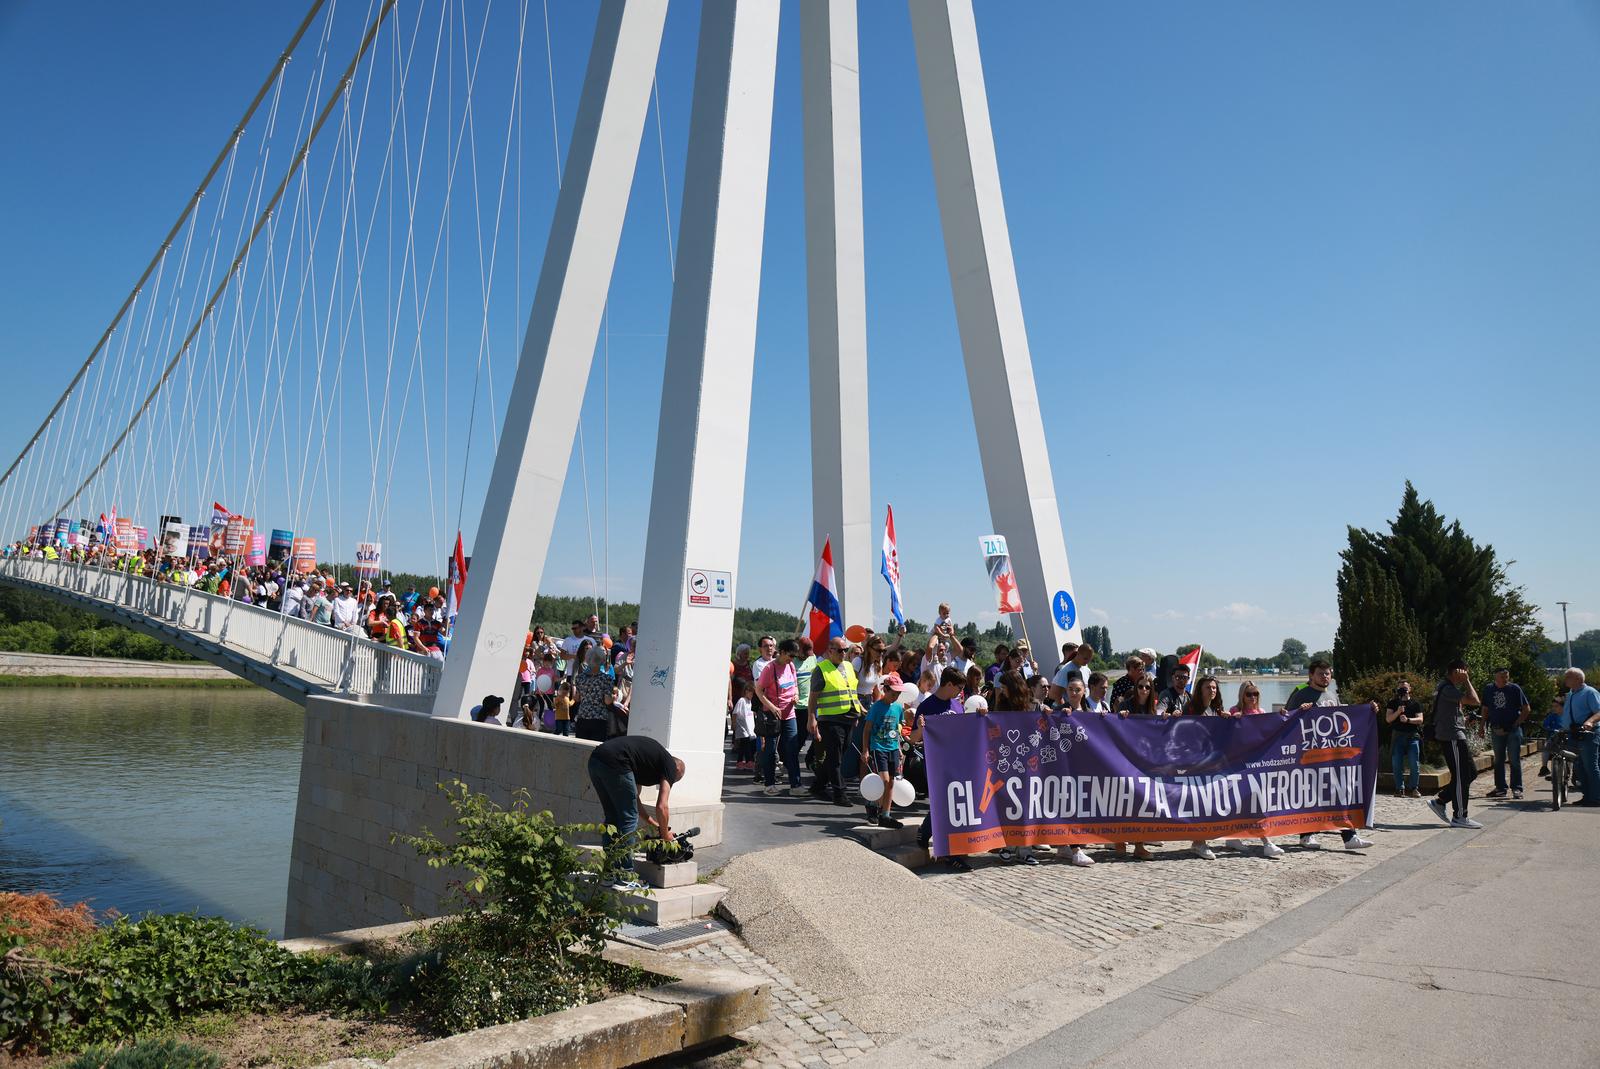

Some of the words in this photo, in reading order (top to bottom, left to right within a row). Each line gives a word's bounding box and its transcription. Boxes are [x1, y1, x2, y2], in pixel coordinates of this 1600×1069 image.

[984, 541, 998, 555] ZA
[1299, 711, 1352, 741] HOD
[1302, 737, 1319, 751] ZA
[1321, 734, 1355, 749] ŽIVOT
[1028, 775, 1135, 820] ROĐENIH
[1138, 776, 1172, 819] ZA
[1174, 769, 1242, 818] ŽIVOT
[1248, 764, 1364, 814] NEROĐENIH
